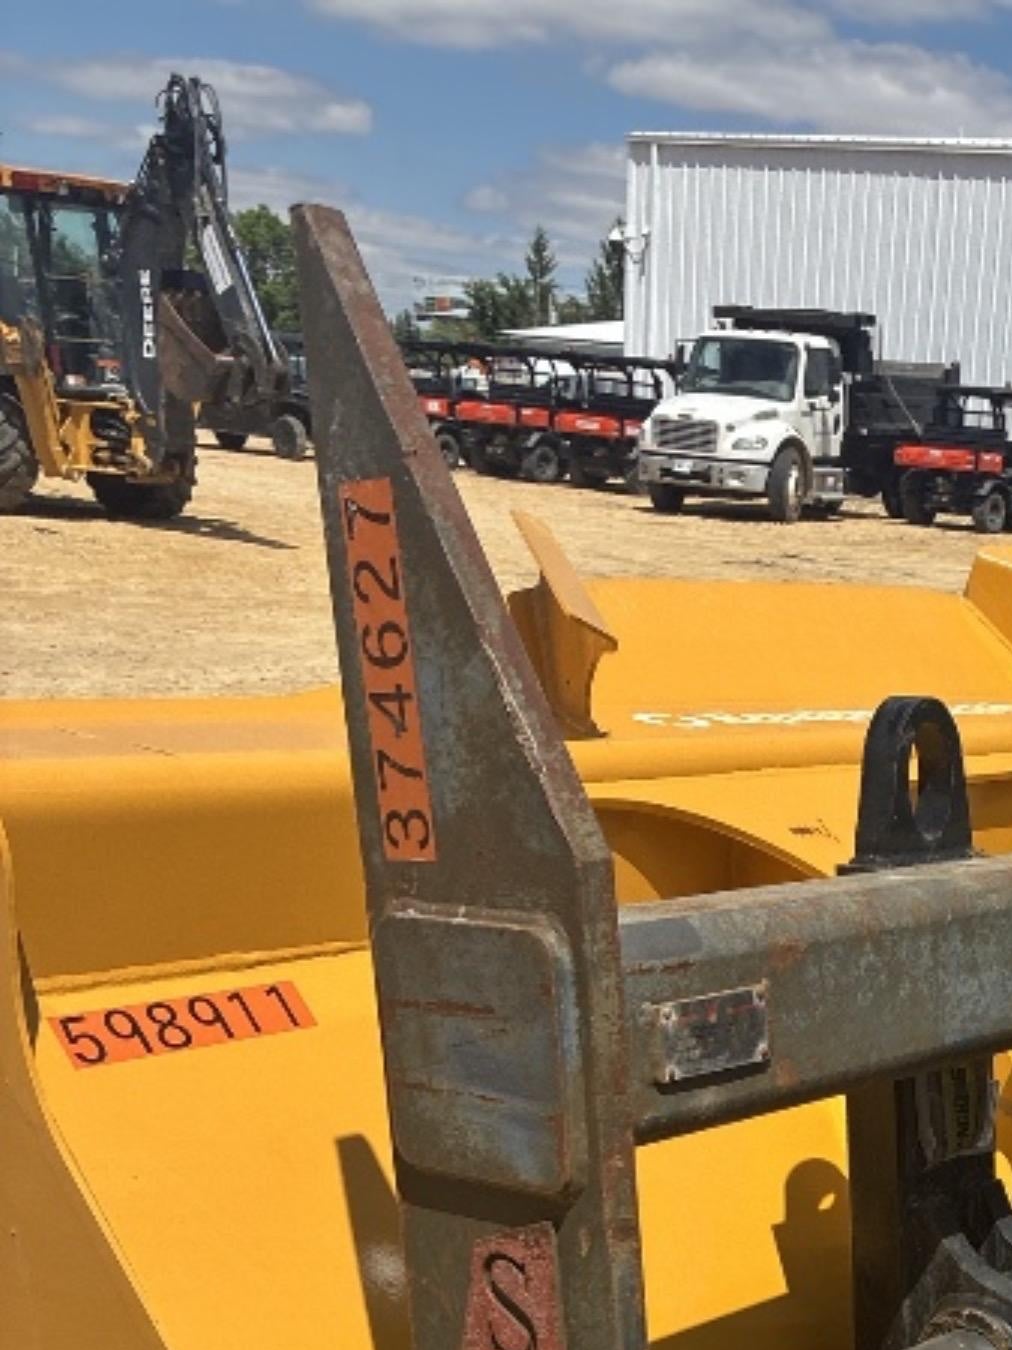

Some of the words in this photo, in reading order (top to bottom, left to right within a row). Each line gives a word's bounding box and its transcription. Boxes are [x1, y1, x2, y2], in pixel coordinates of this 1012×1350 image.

[138, 269, 156, 358] DEERE
[343, 497, 431, 851] 374627
[58, 984, 301, 1065] 598911
